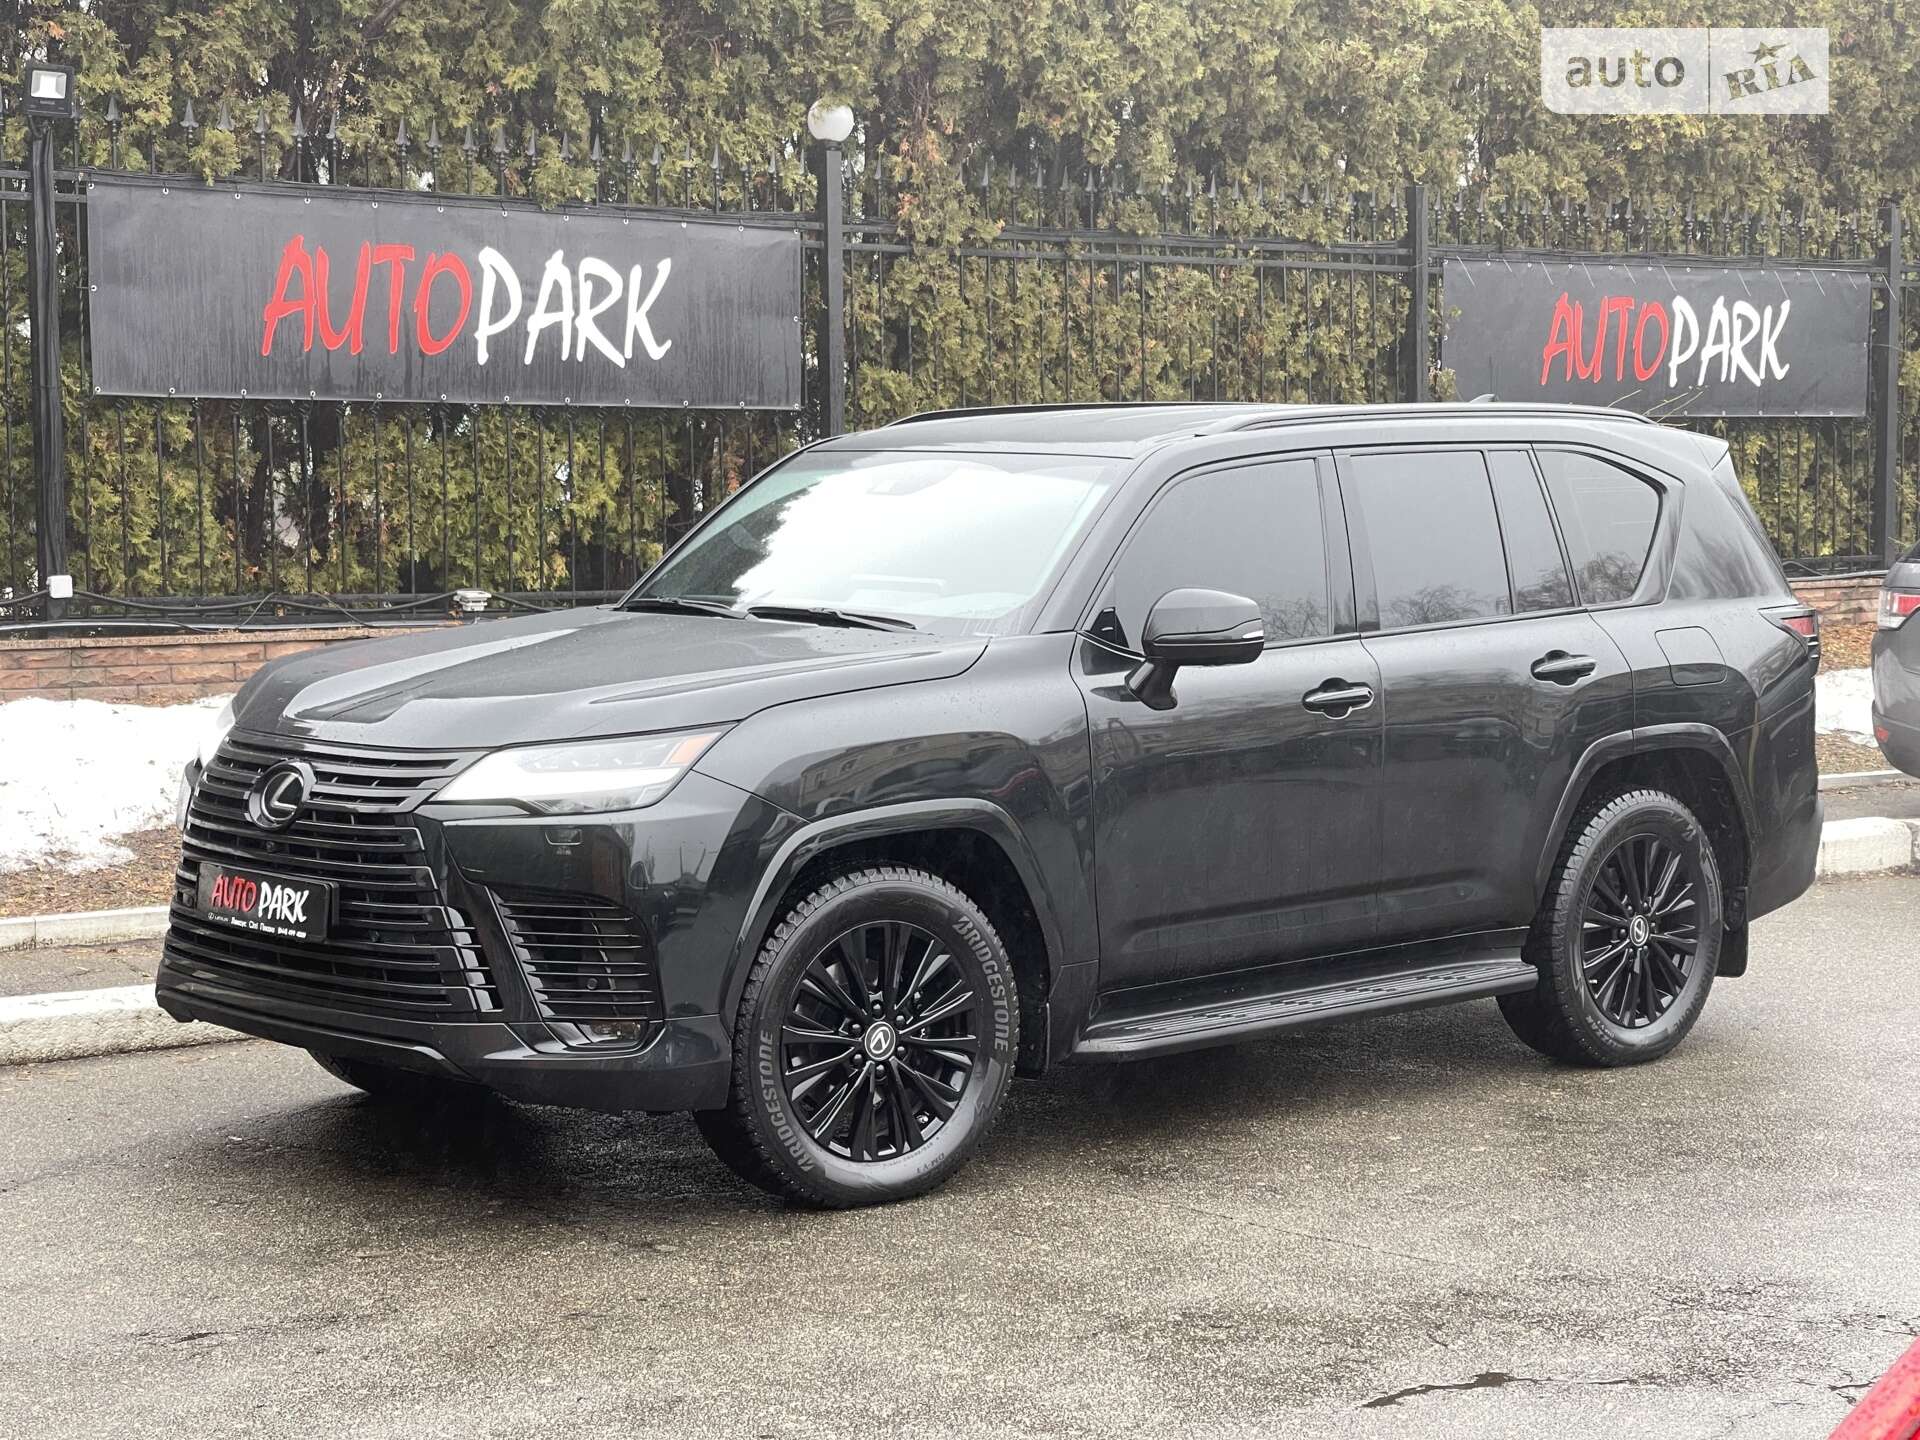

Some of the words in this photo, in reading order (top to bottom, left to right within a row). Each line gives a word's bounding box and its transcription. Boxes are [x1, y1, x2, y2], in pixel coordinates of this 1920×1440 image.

[952, 915, 1010, 1052] BRIDGESTONE
[1585, 1015, 1623, 1048] LIZZAK
[759, 1029, 815, 1172] BRIDGESTONE
